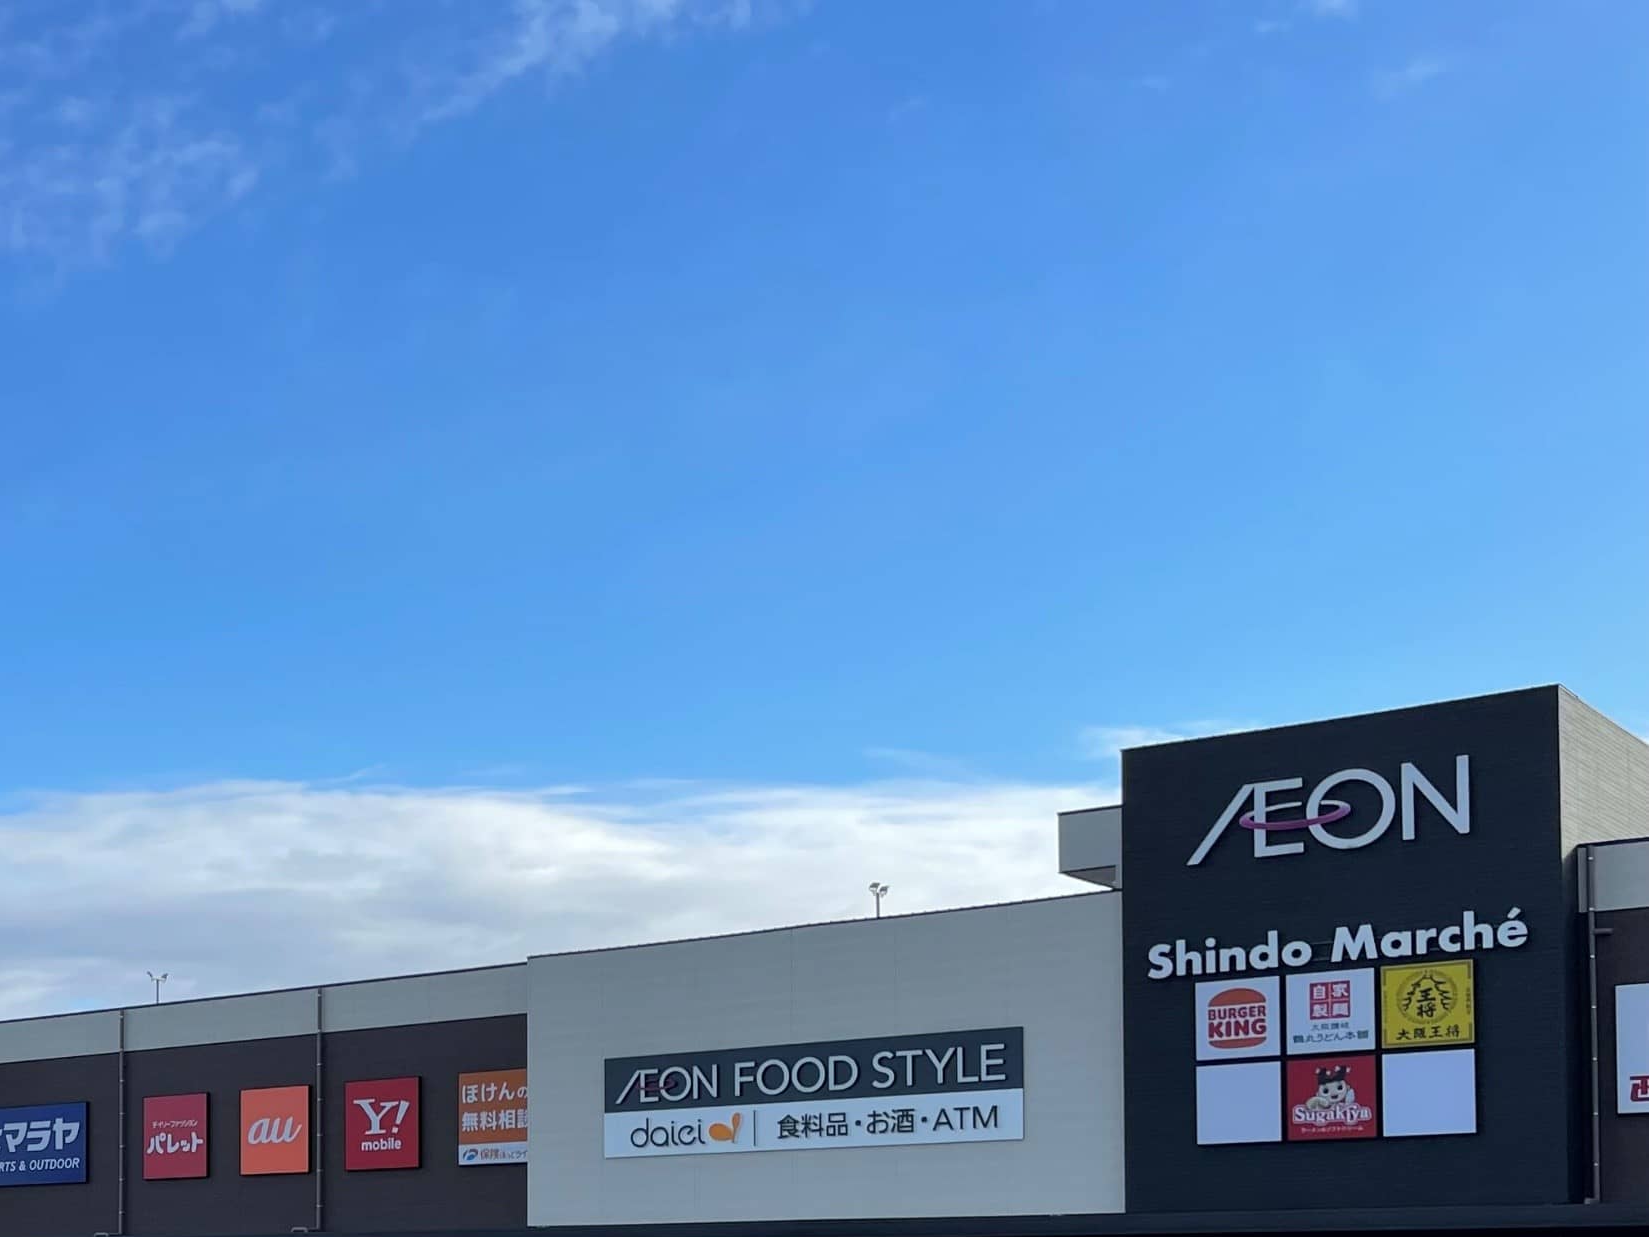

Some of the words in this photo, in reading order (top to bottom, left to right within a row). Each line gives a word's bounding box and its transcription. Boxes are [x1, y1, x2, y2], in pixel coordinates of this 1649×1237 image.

[1148, 930, 1312, 979] Shindo
[1331, 907, 1528, 963] Marché
[1208, 1005, 1266, 1020] BURGER
[1208, 1018, 1267, 1038] KING
[734, 1055, 858, 1097] FOOD
[872, 1043, 1006, 1089] STYLE
[353, 1098, 410, 1135] Y!
[147, 1131, 204, 1154] パレット
[247, 1116, 302, 1145] au
[630, 1117, 706, 1148] daiei
[361, 1137, 402, 1152] mobile
[19, 1160, 26, 1171] &
[29, 1157, 80, 1171] OUTDOOR
